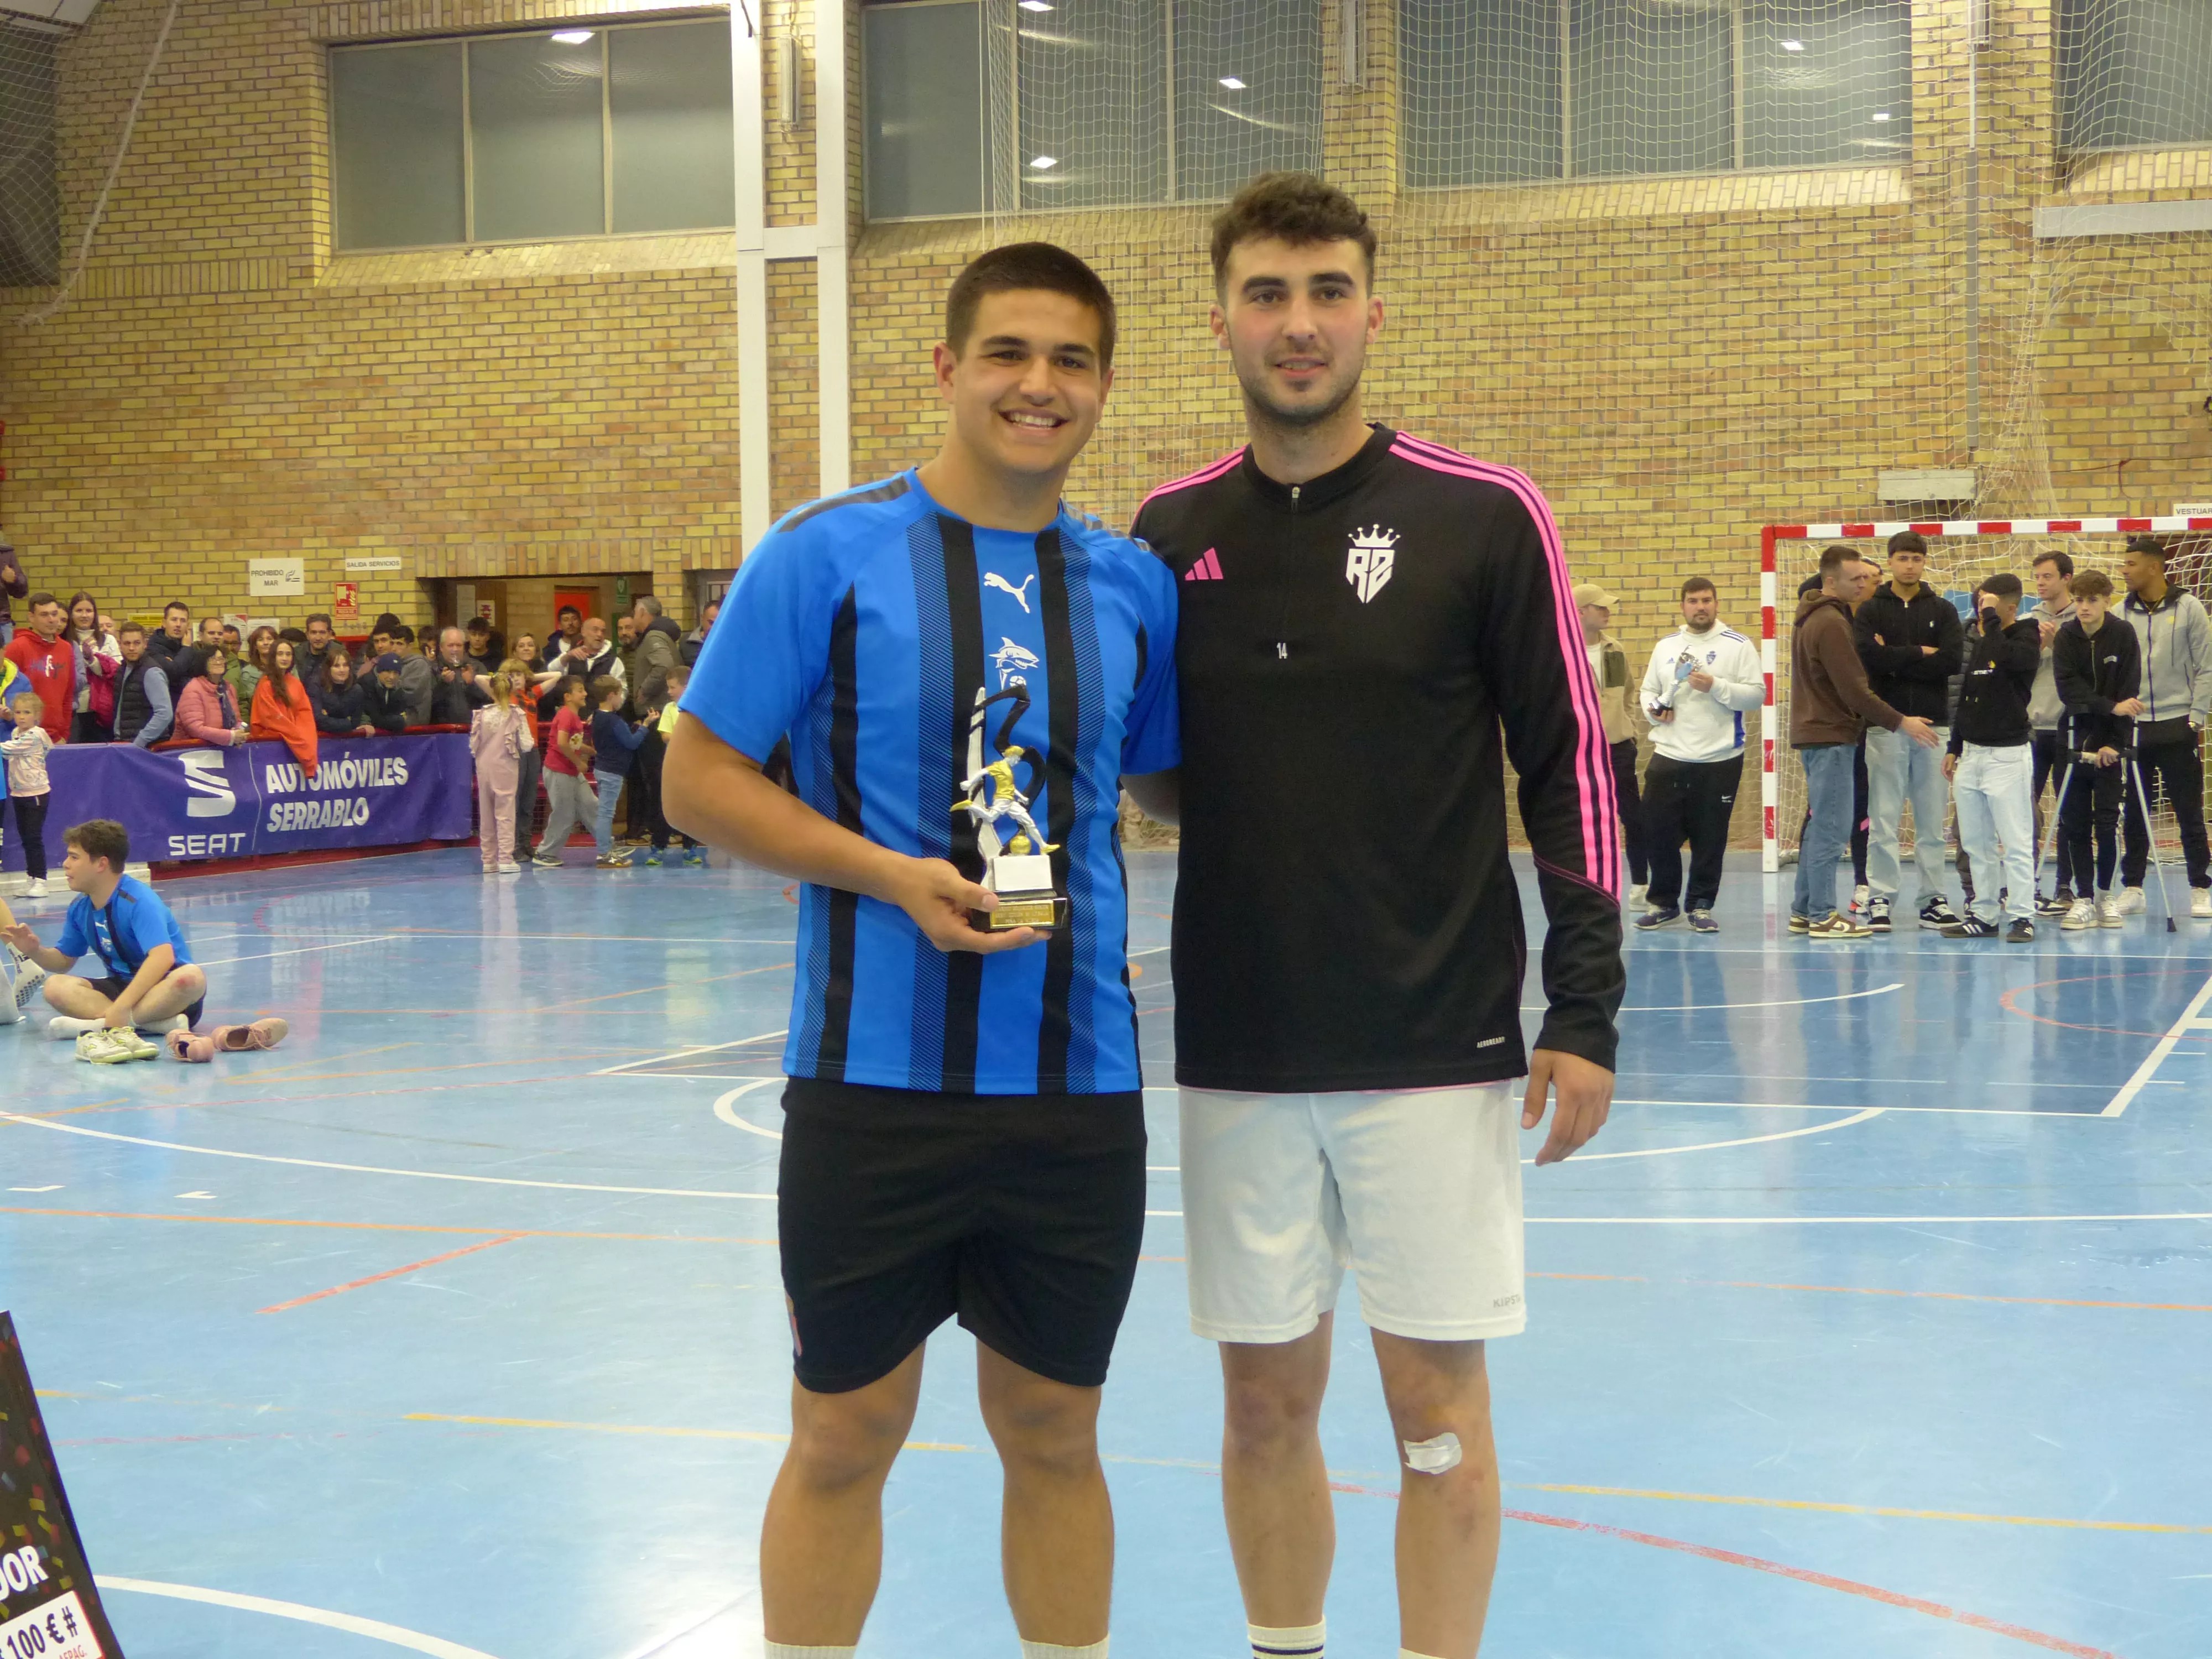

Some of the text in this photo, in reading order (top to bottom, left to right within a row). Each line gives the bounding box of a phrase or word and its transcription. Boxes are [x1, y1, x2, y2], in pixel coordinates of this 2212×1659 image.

[266, 752, 409, 794] AUTOMÓVILES
[267, 797, 369, 832] SERRABLO
[169, 832, 246, 856] SEAT
[7, 1624, 45, 1659] 100
